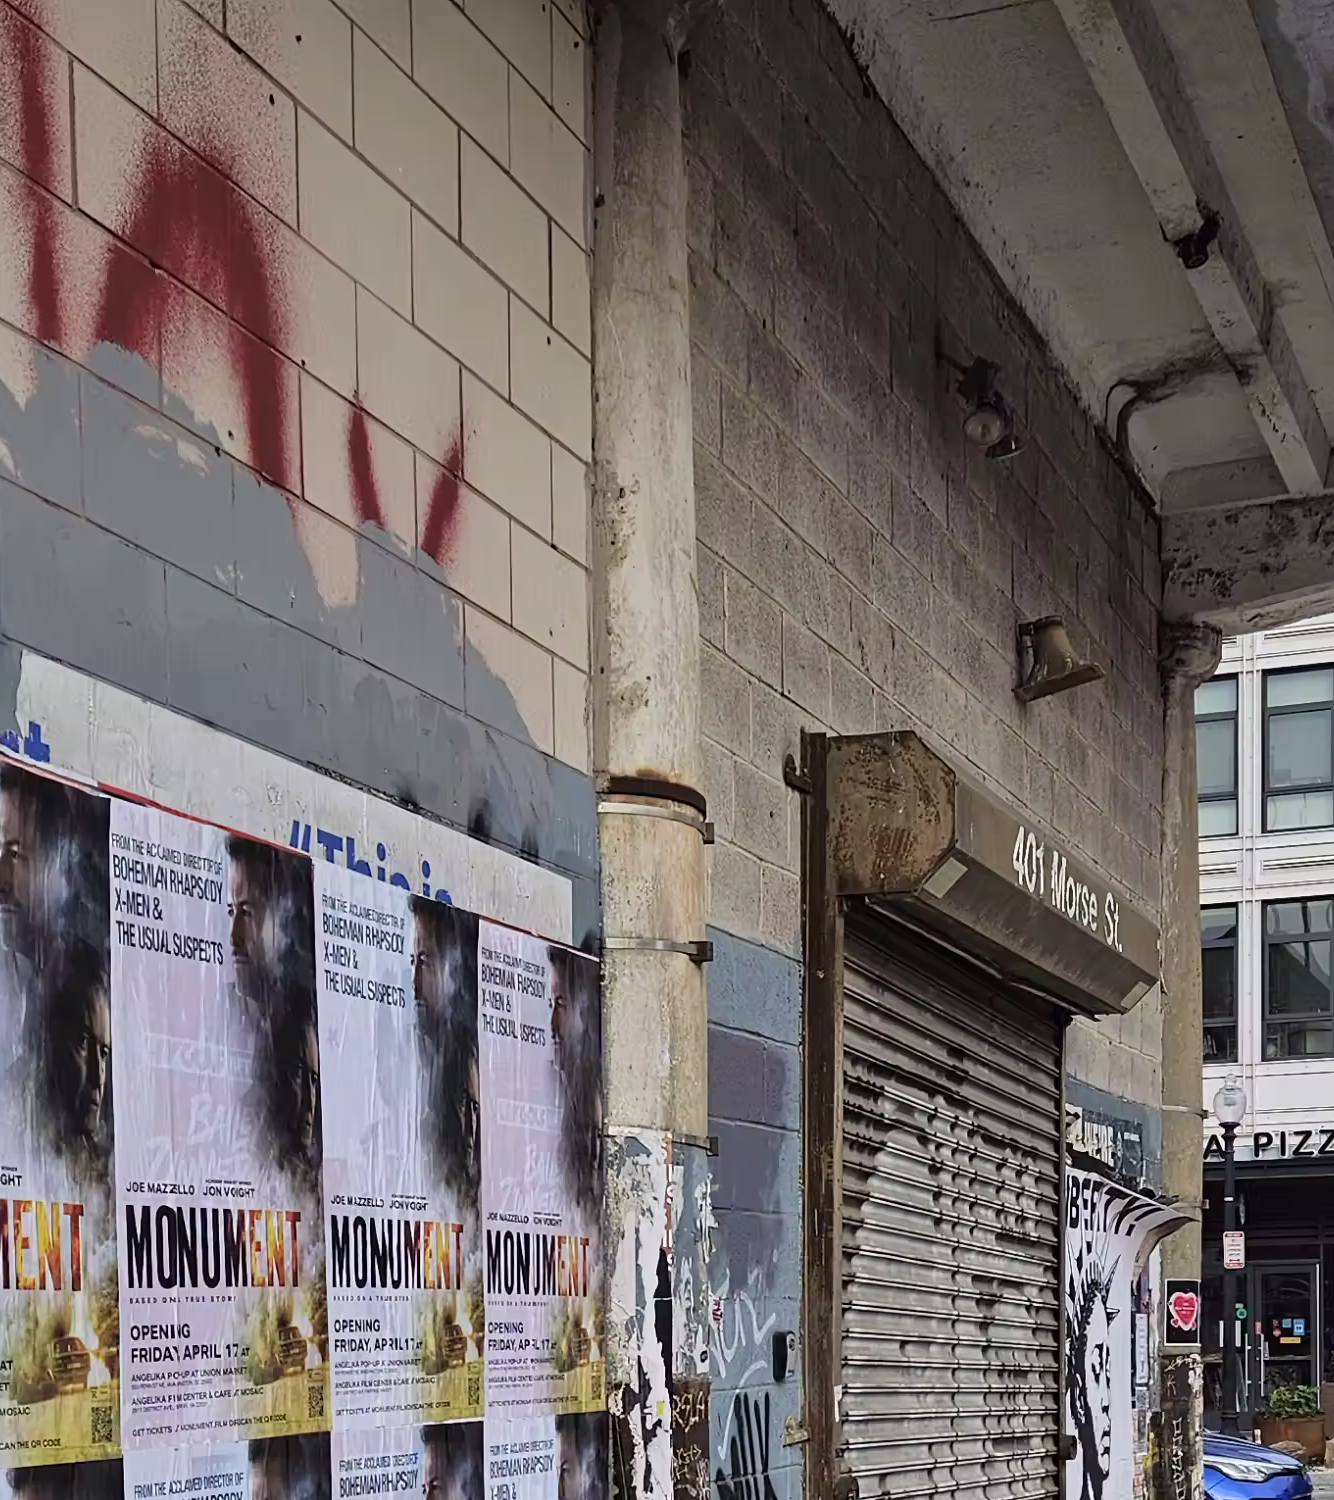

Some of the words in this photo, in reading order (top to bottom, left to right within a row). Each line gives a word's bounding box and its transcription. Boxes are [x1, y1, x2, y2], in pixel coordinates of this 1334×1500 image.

[1012, 825, 1045, 895] 401
[1050, 850, 1099, 932] Morse
[1104, 891, 1123, 953] St.
[125, 1205, 302, 1290] MONUMENT
[331, 1215, 464, 1291] MONUMENT
